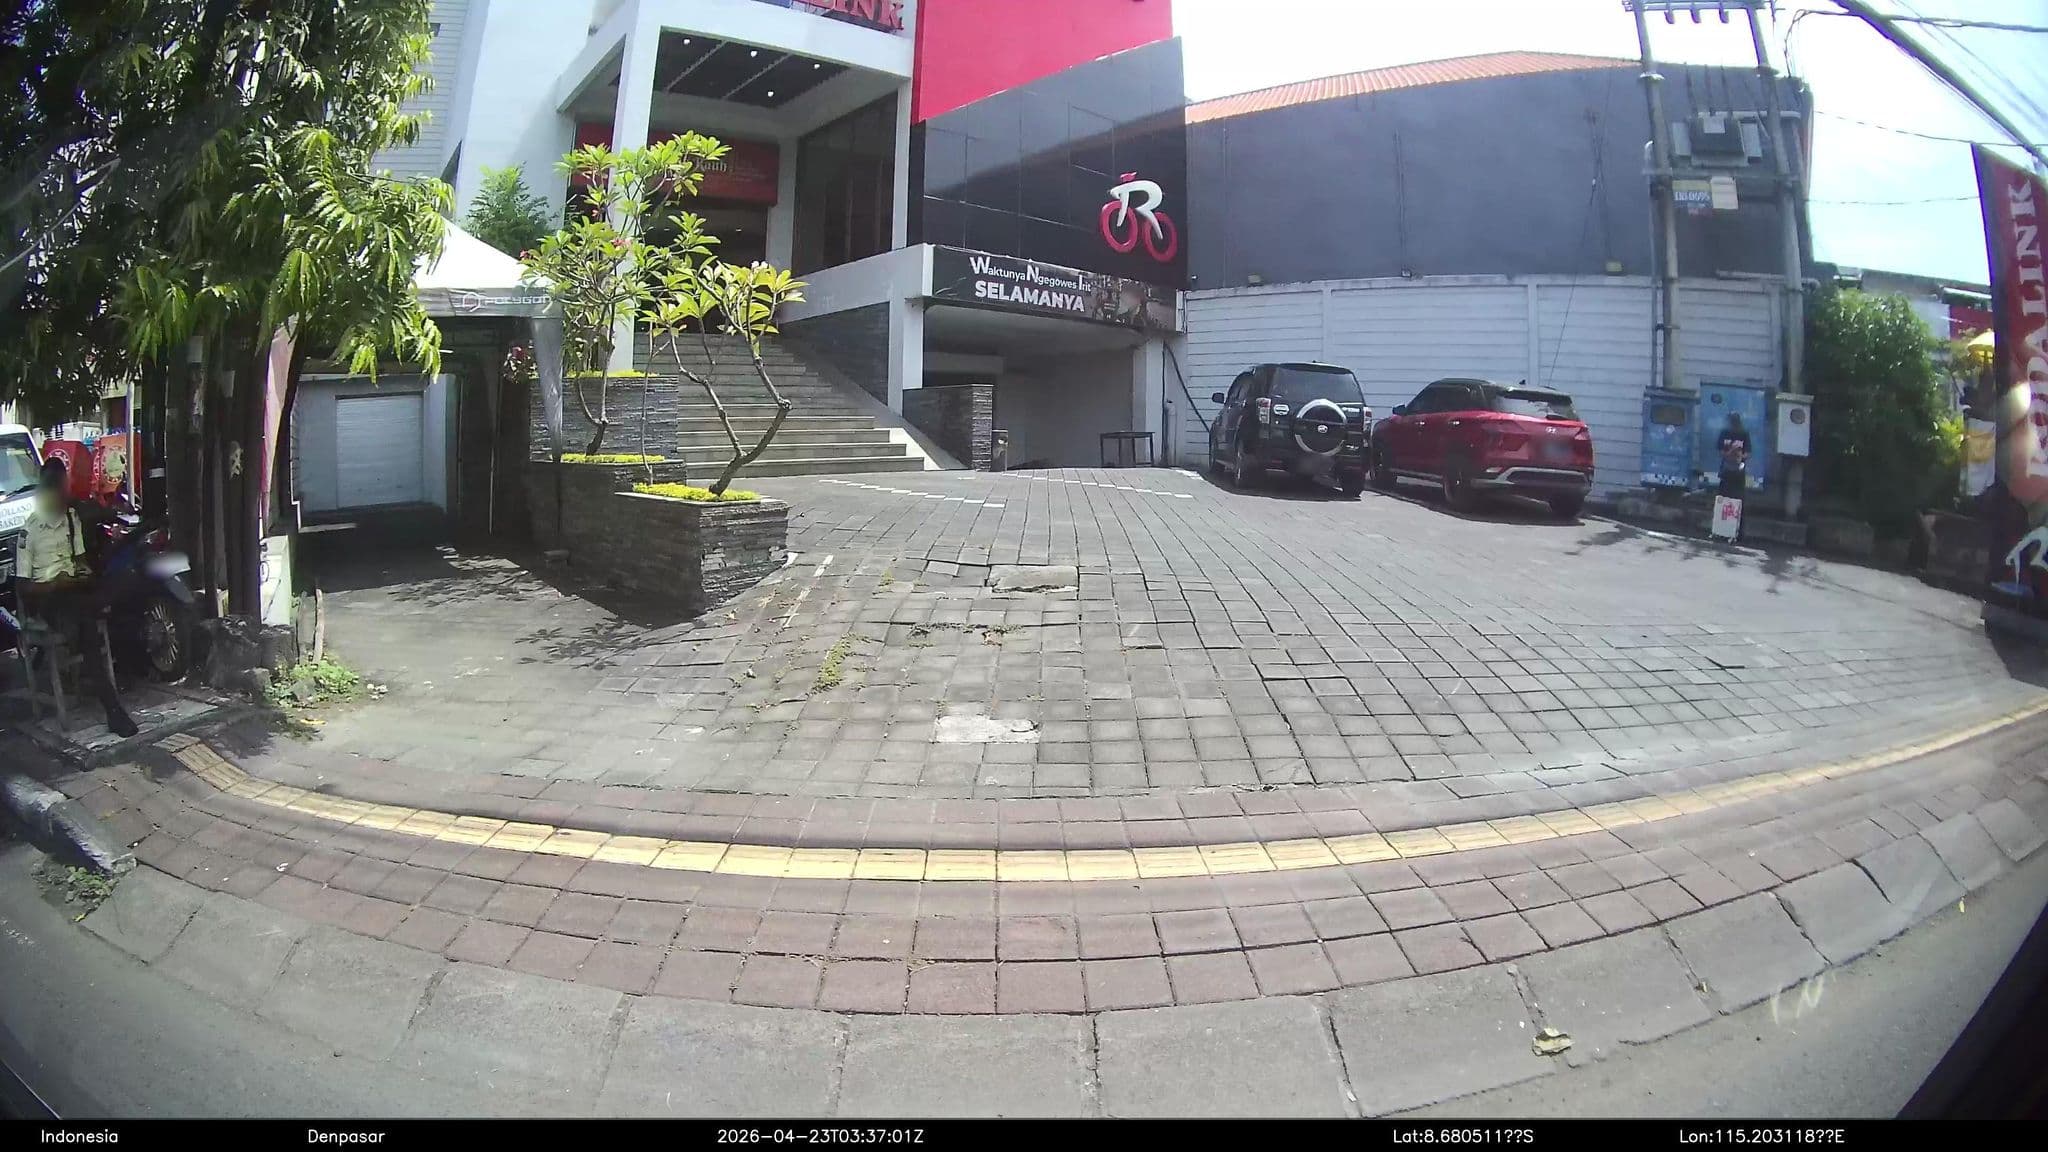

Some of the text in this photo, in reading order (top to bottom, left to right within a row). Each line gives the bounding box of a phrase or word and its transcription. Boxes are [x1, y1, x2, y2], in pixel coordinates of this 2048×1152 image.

[969, 256, 1026, 283] Waktunya
[1026, 264, 1077, 290] Ngegowes
[975, 280, 1085, 312] SELAMANYA
